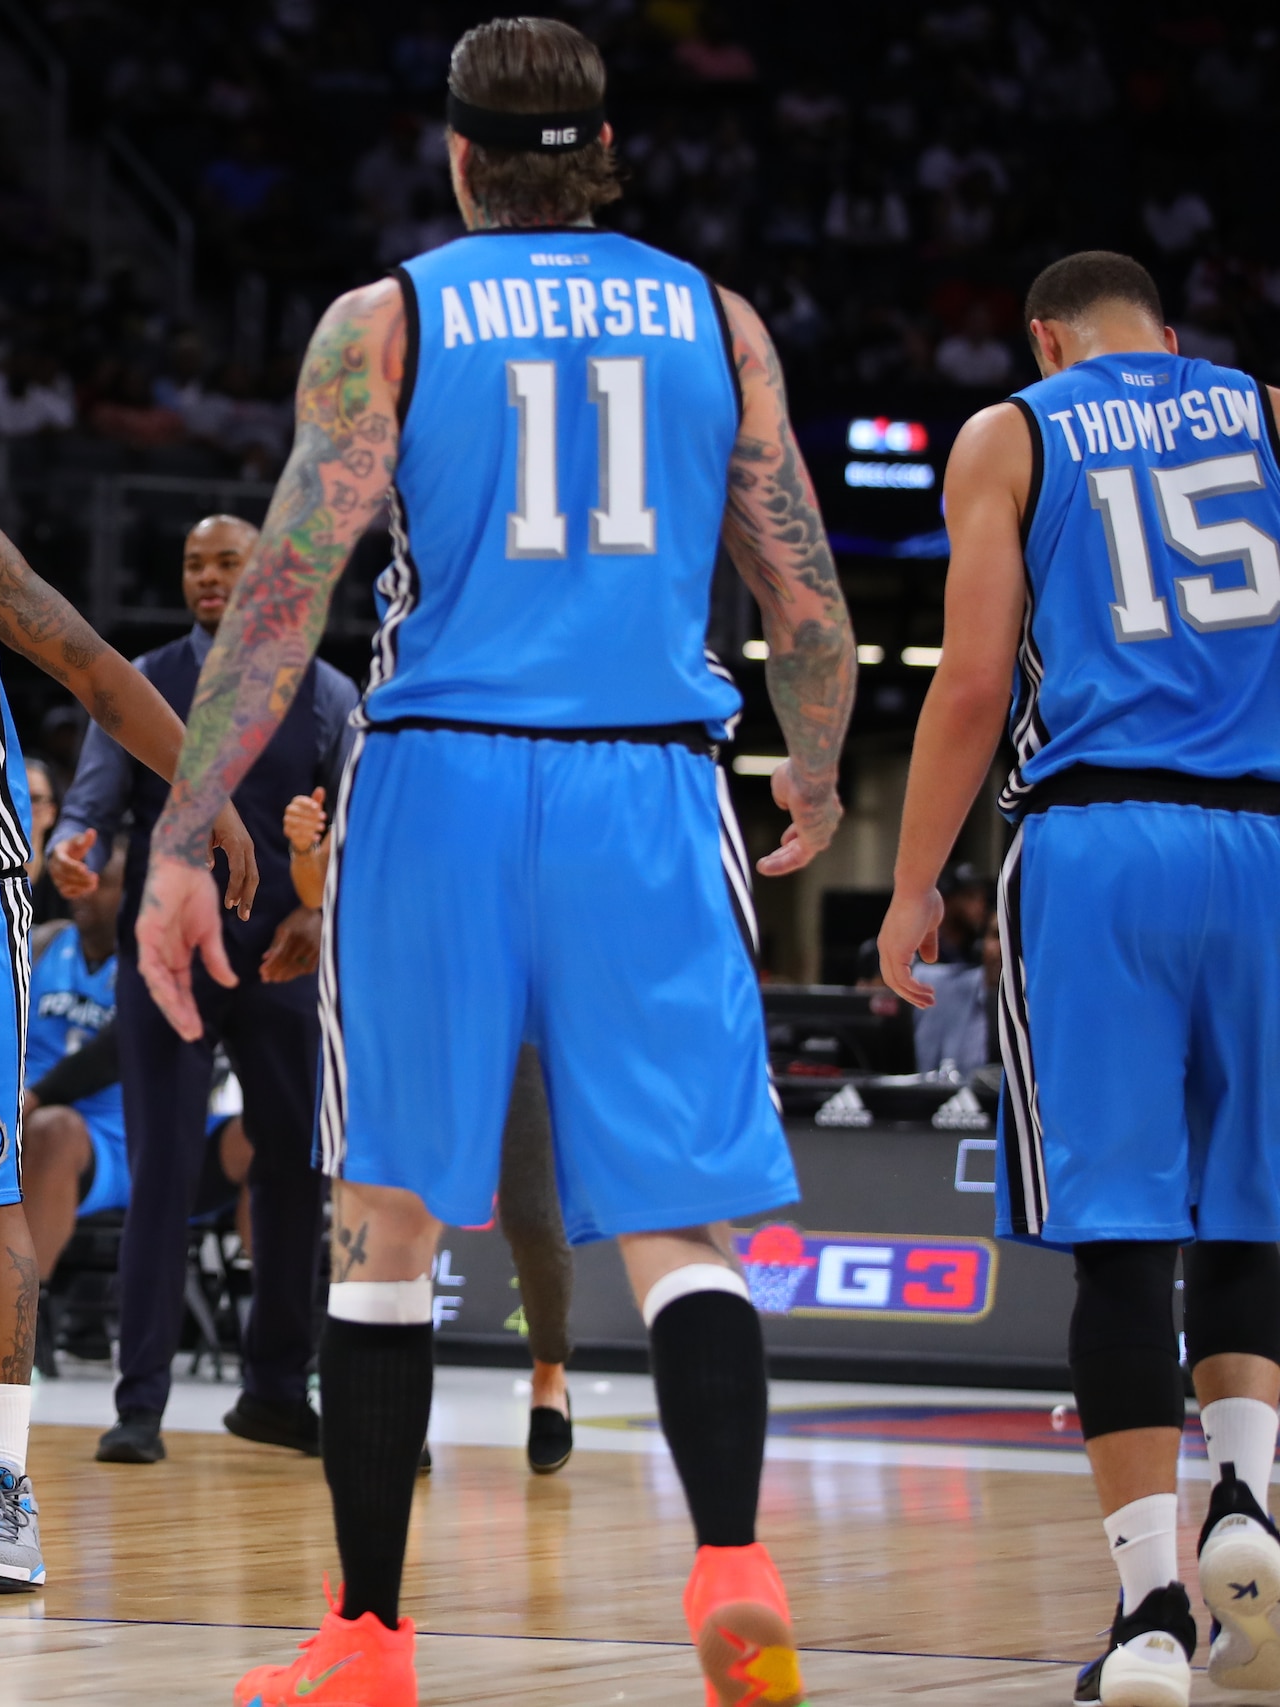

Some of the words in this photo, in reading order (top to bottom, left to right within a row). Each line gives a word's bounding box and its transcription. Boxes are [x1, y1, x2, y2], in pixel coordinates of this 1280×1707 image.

[541, 128, 578, 146] BIG
[529, 253, 591, 267] BIG3
[441, 277, 696, 349] ANDERSEN
[1121, 372, 1170, 387] BIG3
[505, 356, 657, 560] 11
[1047, 386, 1261, 462] THOMPSON
[1085, 451, 1280, 644] 15
